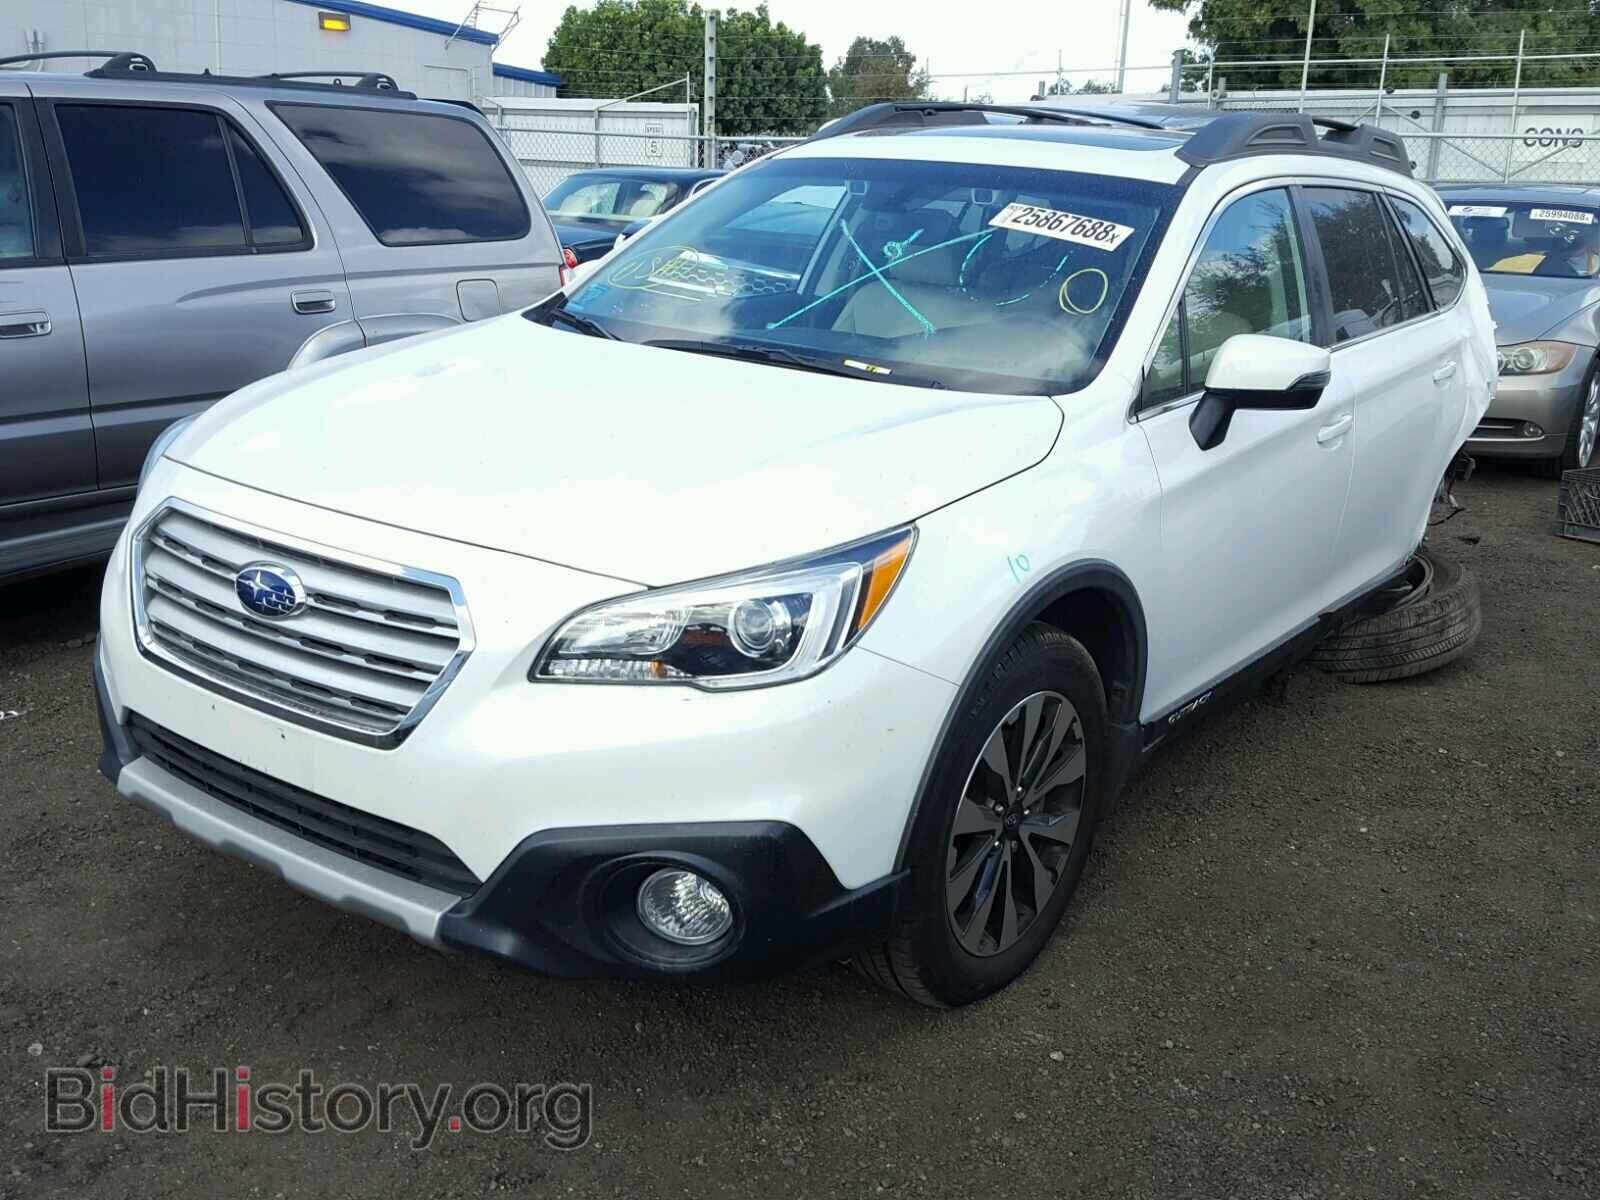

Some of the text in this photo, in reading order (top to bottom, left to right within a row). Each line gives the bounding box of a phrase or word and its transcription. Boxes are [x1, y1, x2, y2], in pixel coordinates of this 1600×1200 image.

[650, 140, 658, 153] 5
[1523, 127, 1584, 148] CONS
[1007, 554, 1031, 584] 10
